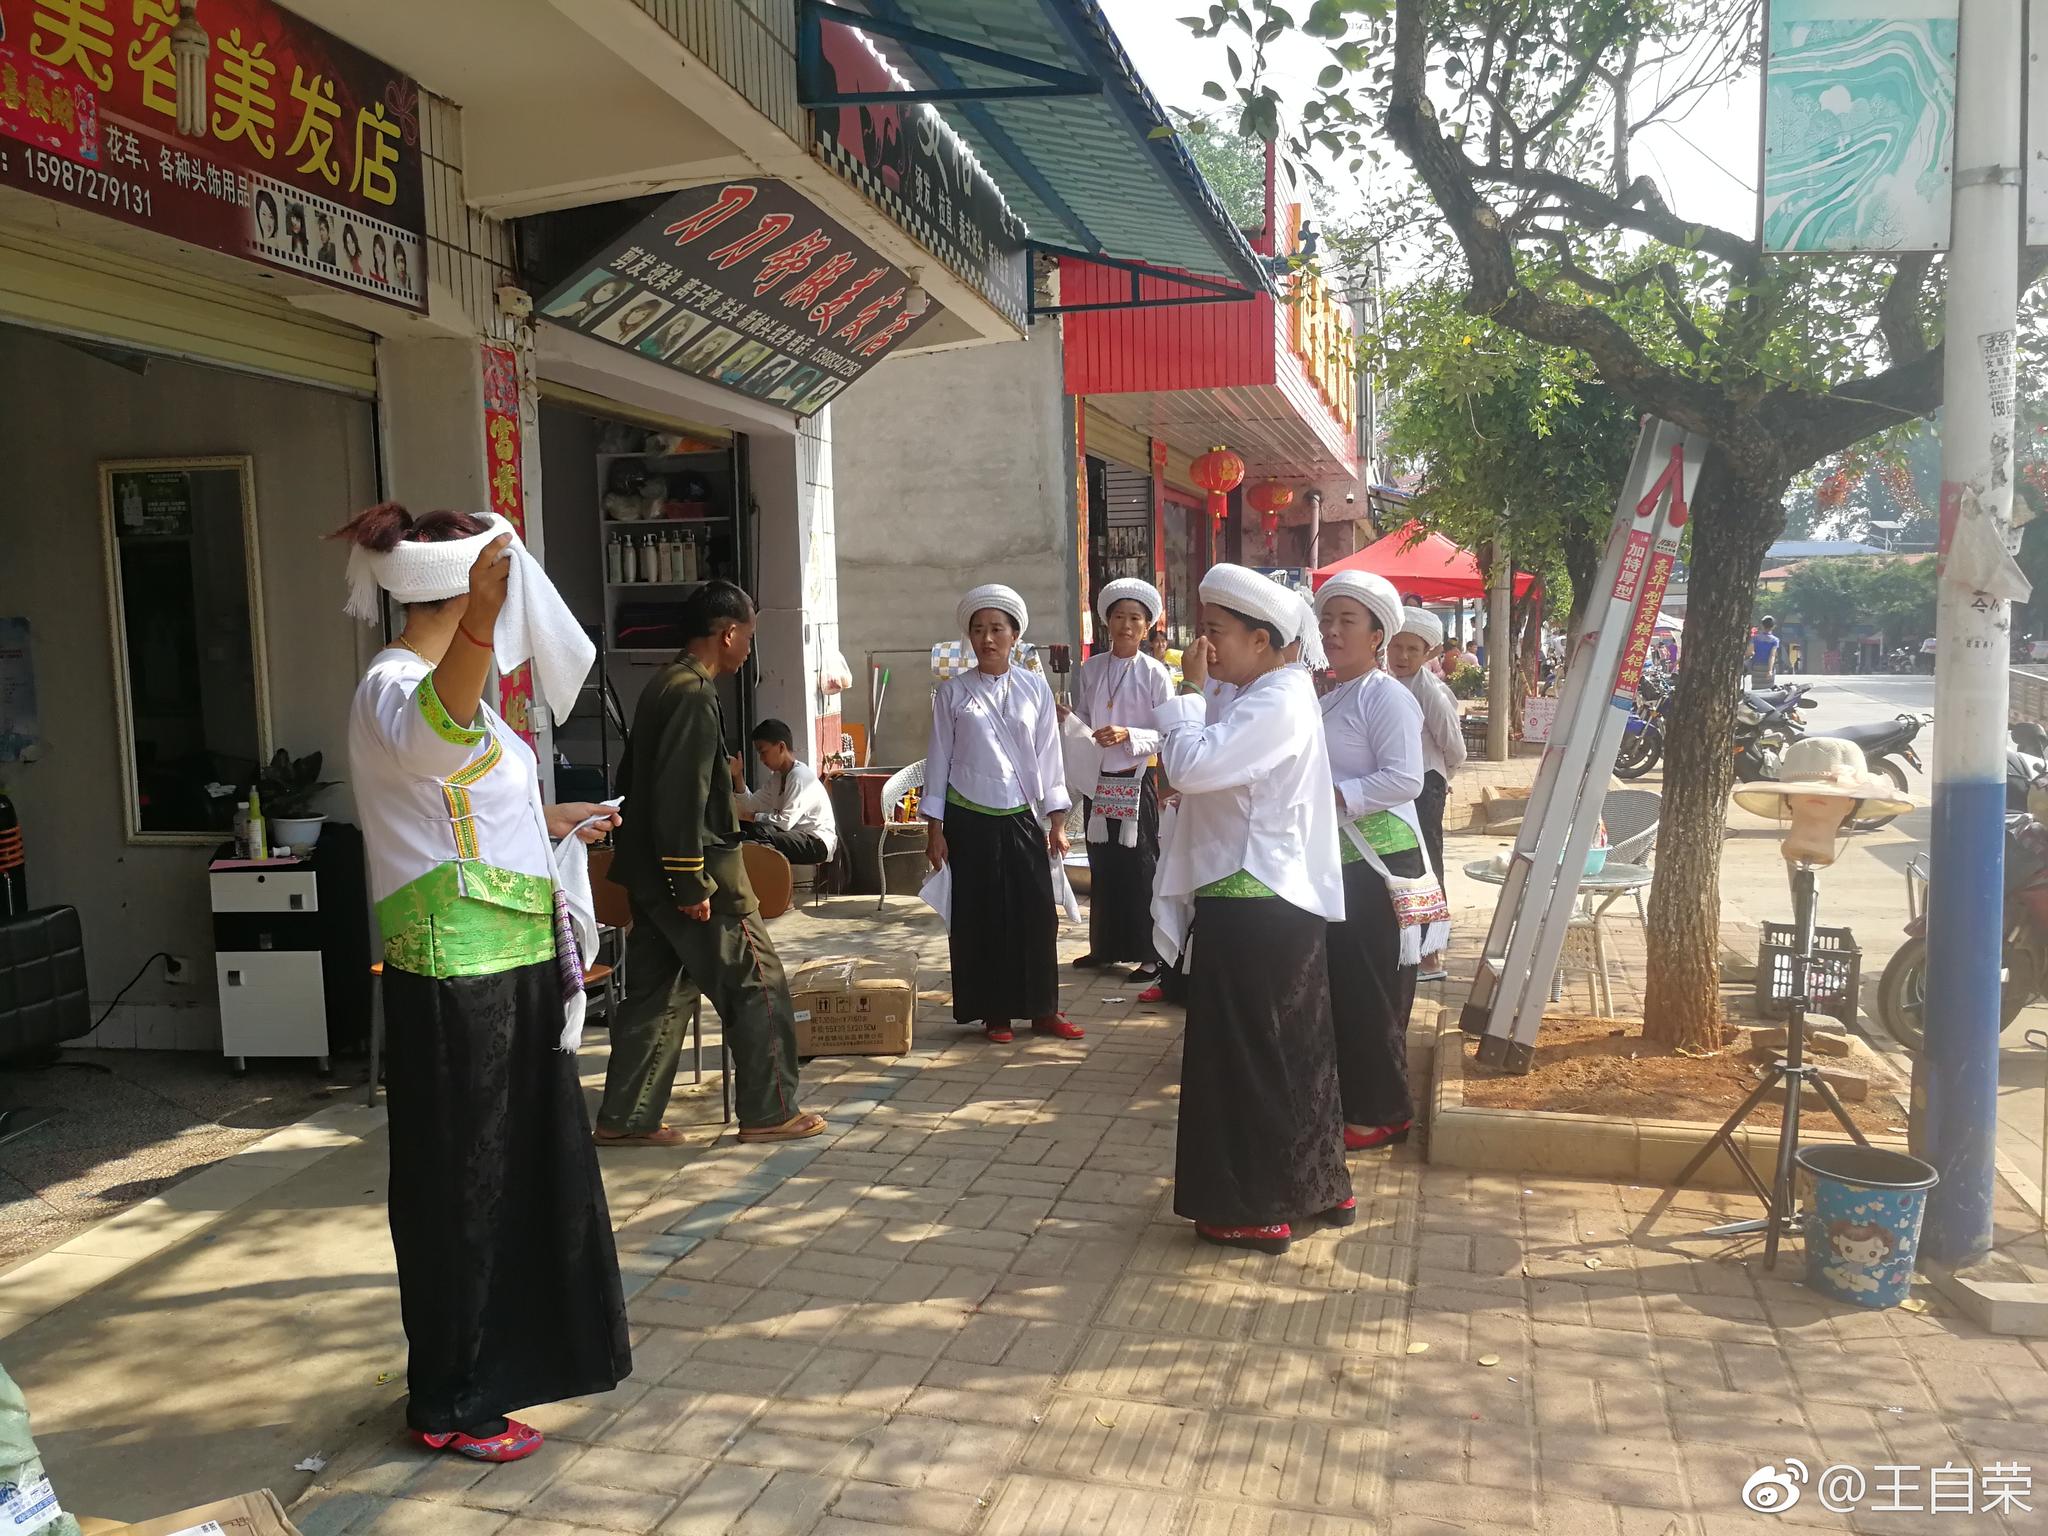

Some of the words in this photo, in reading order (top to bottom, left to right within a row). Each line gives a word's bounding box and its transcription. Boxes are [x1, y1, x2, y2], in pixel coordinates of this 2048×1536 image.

[25, 147, 151, 217] 15987279131
[105, 124, 251, 208] 花车、各种头饰用品
[664, 185, 931, 358] 刀刀舒服美发店
[670, 277, 724, 311] 离子烫
[710, 296, 748, 323] 洗头
[1614, 542, 1645, 600] 加特厚型
[1621, 558, 1669, 685] 豪华型高强度铝梯
